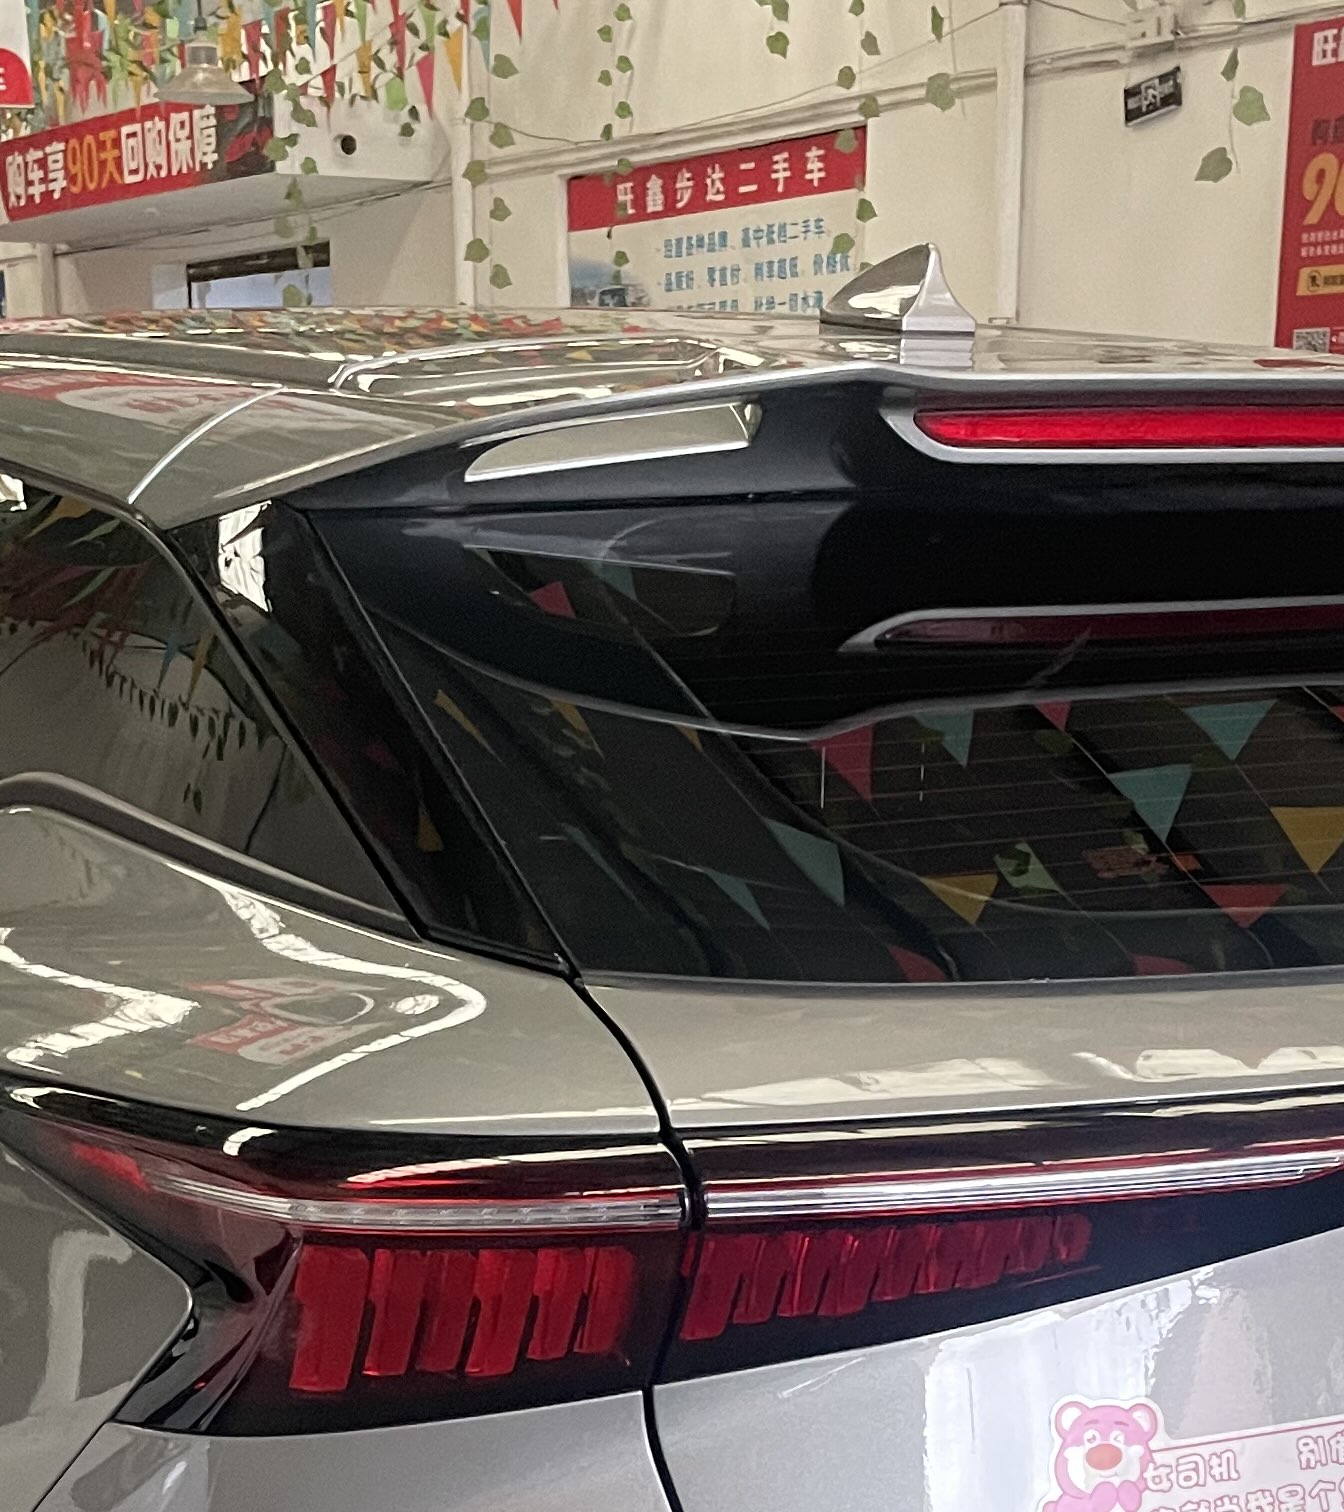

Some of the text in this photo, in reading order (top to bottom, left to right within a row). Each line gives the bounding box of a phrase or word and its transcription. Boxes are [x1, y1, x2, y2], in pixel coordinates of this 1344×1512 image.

[617, 146, 826, 215] 旺鑫步达二手车
[1143, 1449, 1241, 1493] 女司机
